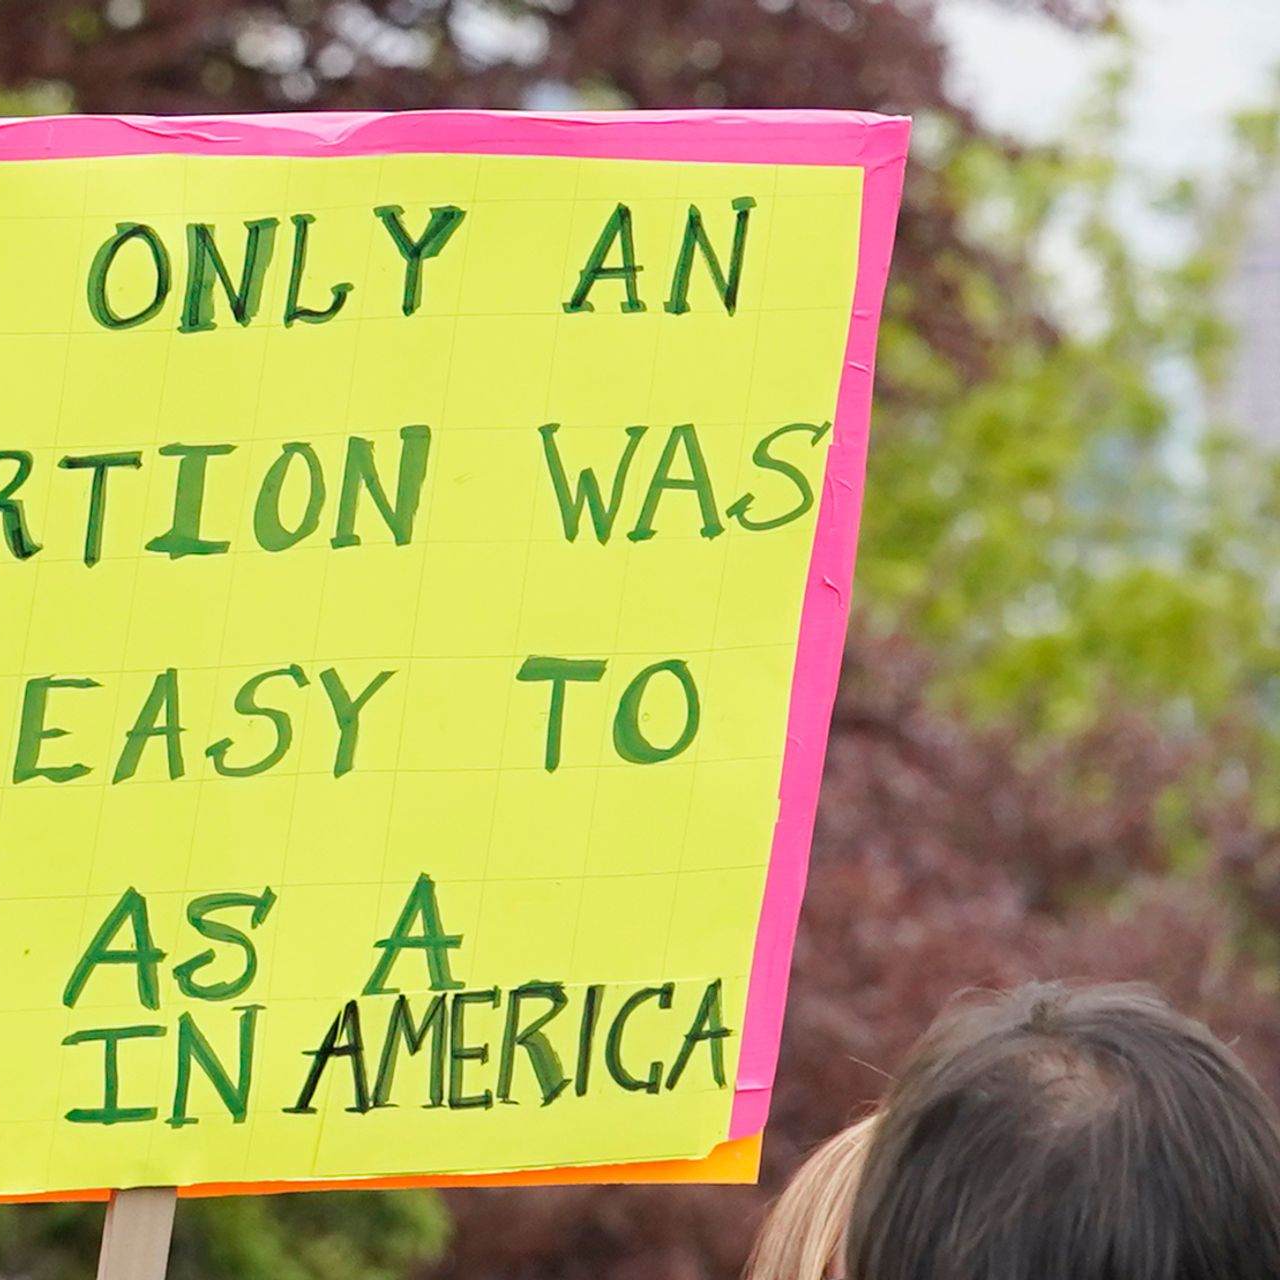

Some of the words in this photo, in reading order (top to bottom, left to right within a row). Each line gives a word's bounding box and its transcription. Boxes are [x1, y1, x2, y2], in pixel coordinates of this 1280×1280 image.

[87, 205, 466, 333] ONLY
[563, 197, 756, 316] AN
[538, 422, 831, 545] WAS
[13, 664, 395, 784] EASY
[516, 657, 699, 773] TO
[63, 886, 277, 1010] AS
[362, 873, 465, 996] A
[62, 1005, 265, 1128] IN
[282, 978, 732, 1115] AMERICA
